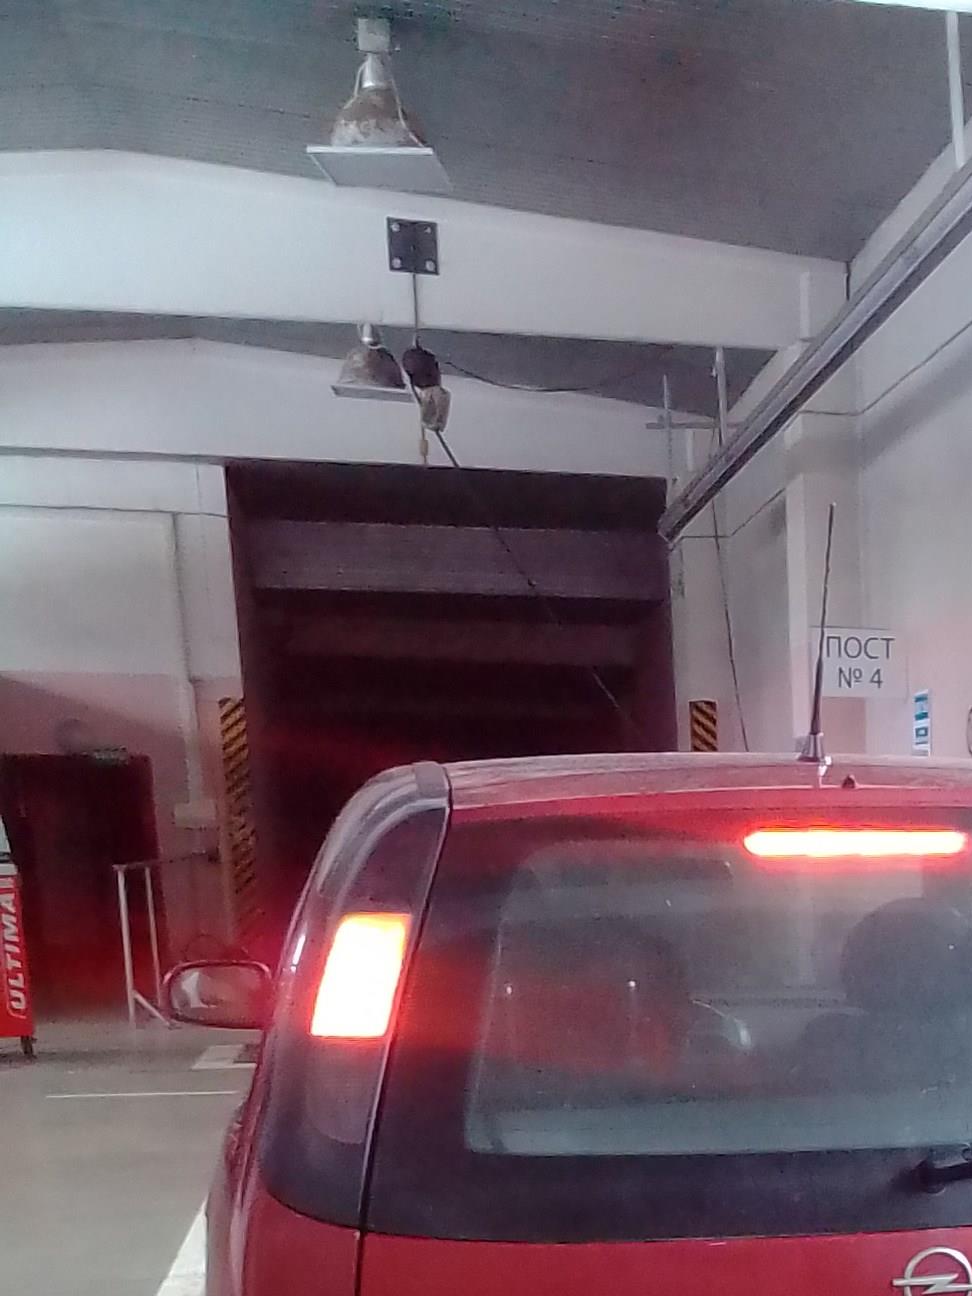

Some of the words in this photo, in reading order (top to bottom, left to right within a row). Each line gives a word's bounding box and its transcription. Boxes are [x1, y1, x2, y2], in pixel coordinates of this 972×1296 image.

[826, 635, 895, 660] ПОСТ
[838, 666, 863, 689] №
[869, 667, 883, 689] 4
[1, 892, 26, 1010] ULTIMA
